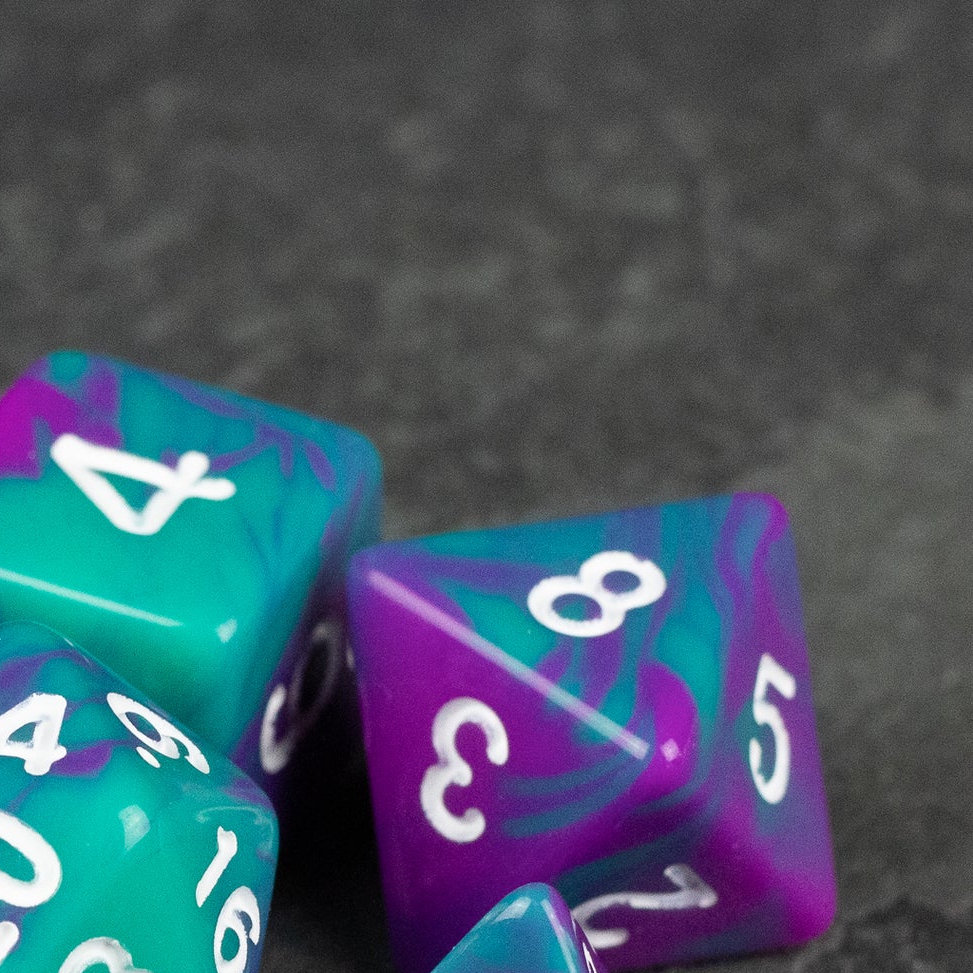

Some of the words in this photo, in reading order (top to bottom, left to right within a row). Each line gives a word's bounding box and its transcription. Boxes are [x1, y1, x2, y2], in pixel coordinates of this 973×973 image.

[50, 433, 236, 535] 4
[527, 550, 667, 638] 8
[420, 698, 509, 843] 3
[749, 654, 796, 804] 5
